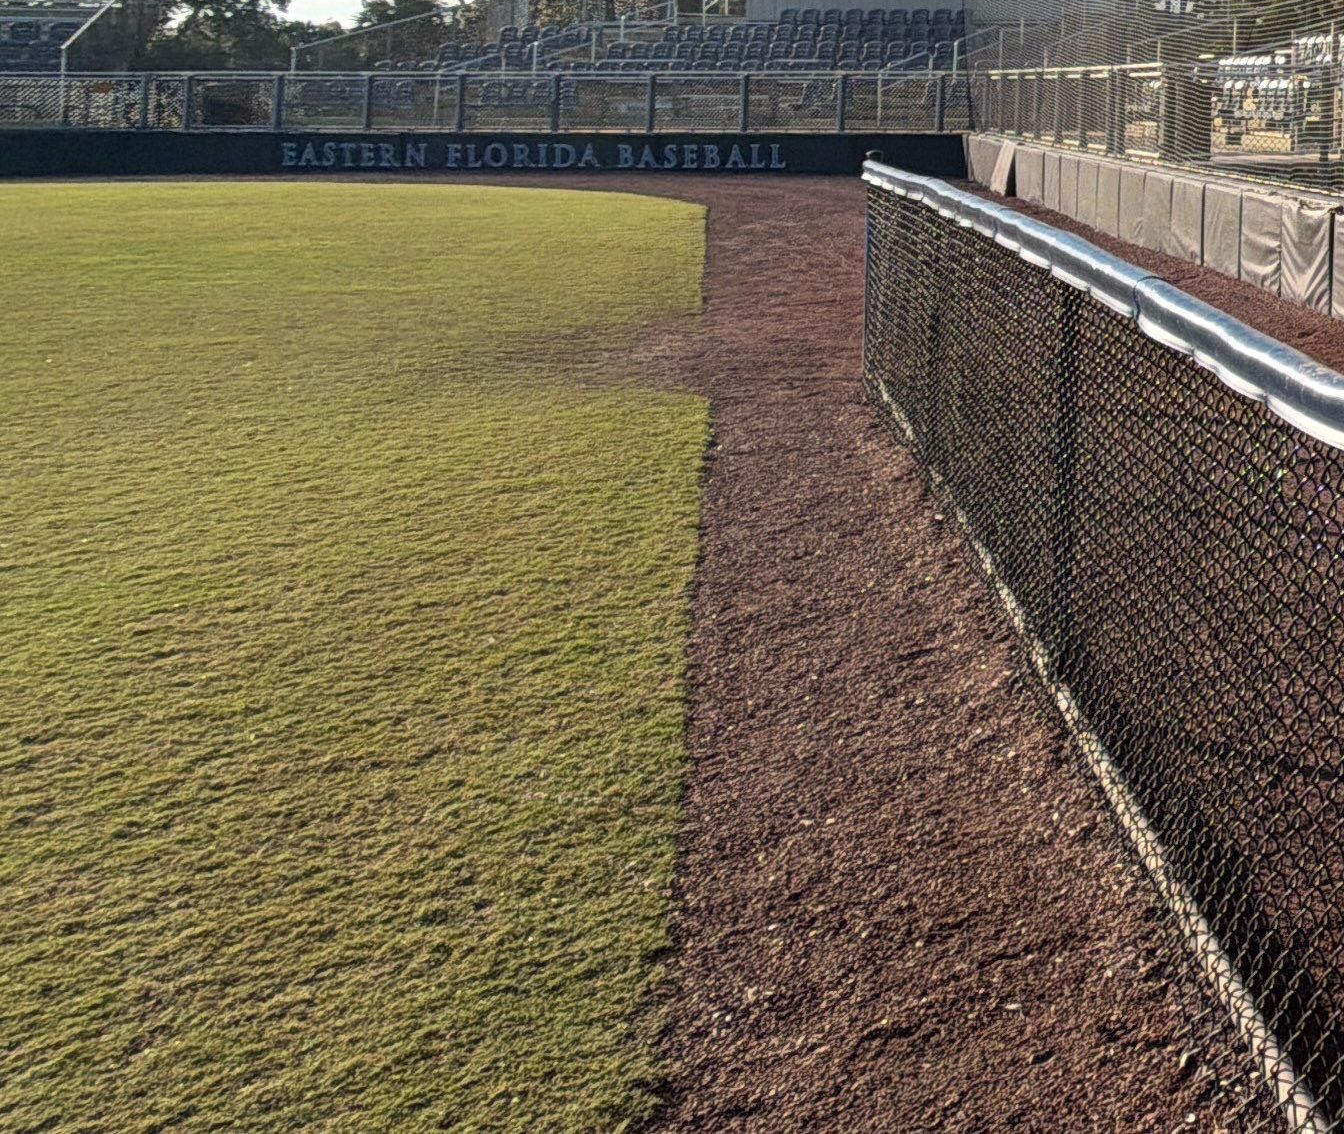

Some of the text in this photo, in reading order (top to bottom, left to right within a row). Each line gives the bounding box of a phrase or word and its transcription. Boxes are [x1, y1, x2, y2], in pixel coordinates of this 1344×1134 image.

[281, 142, 786, 169] EASTERN FLORIDA BASEBALL
